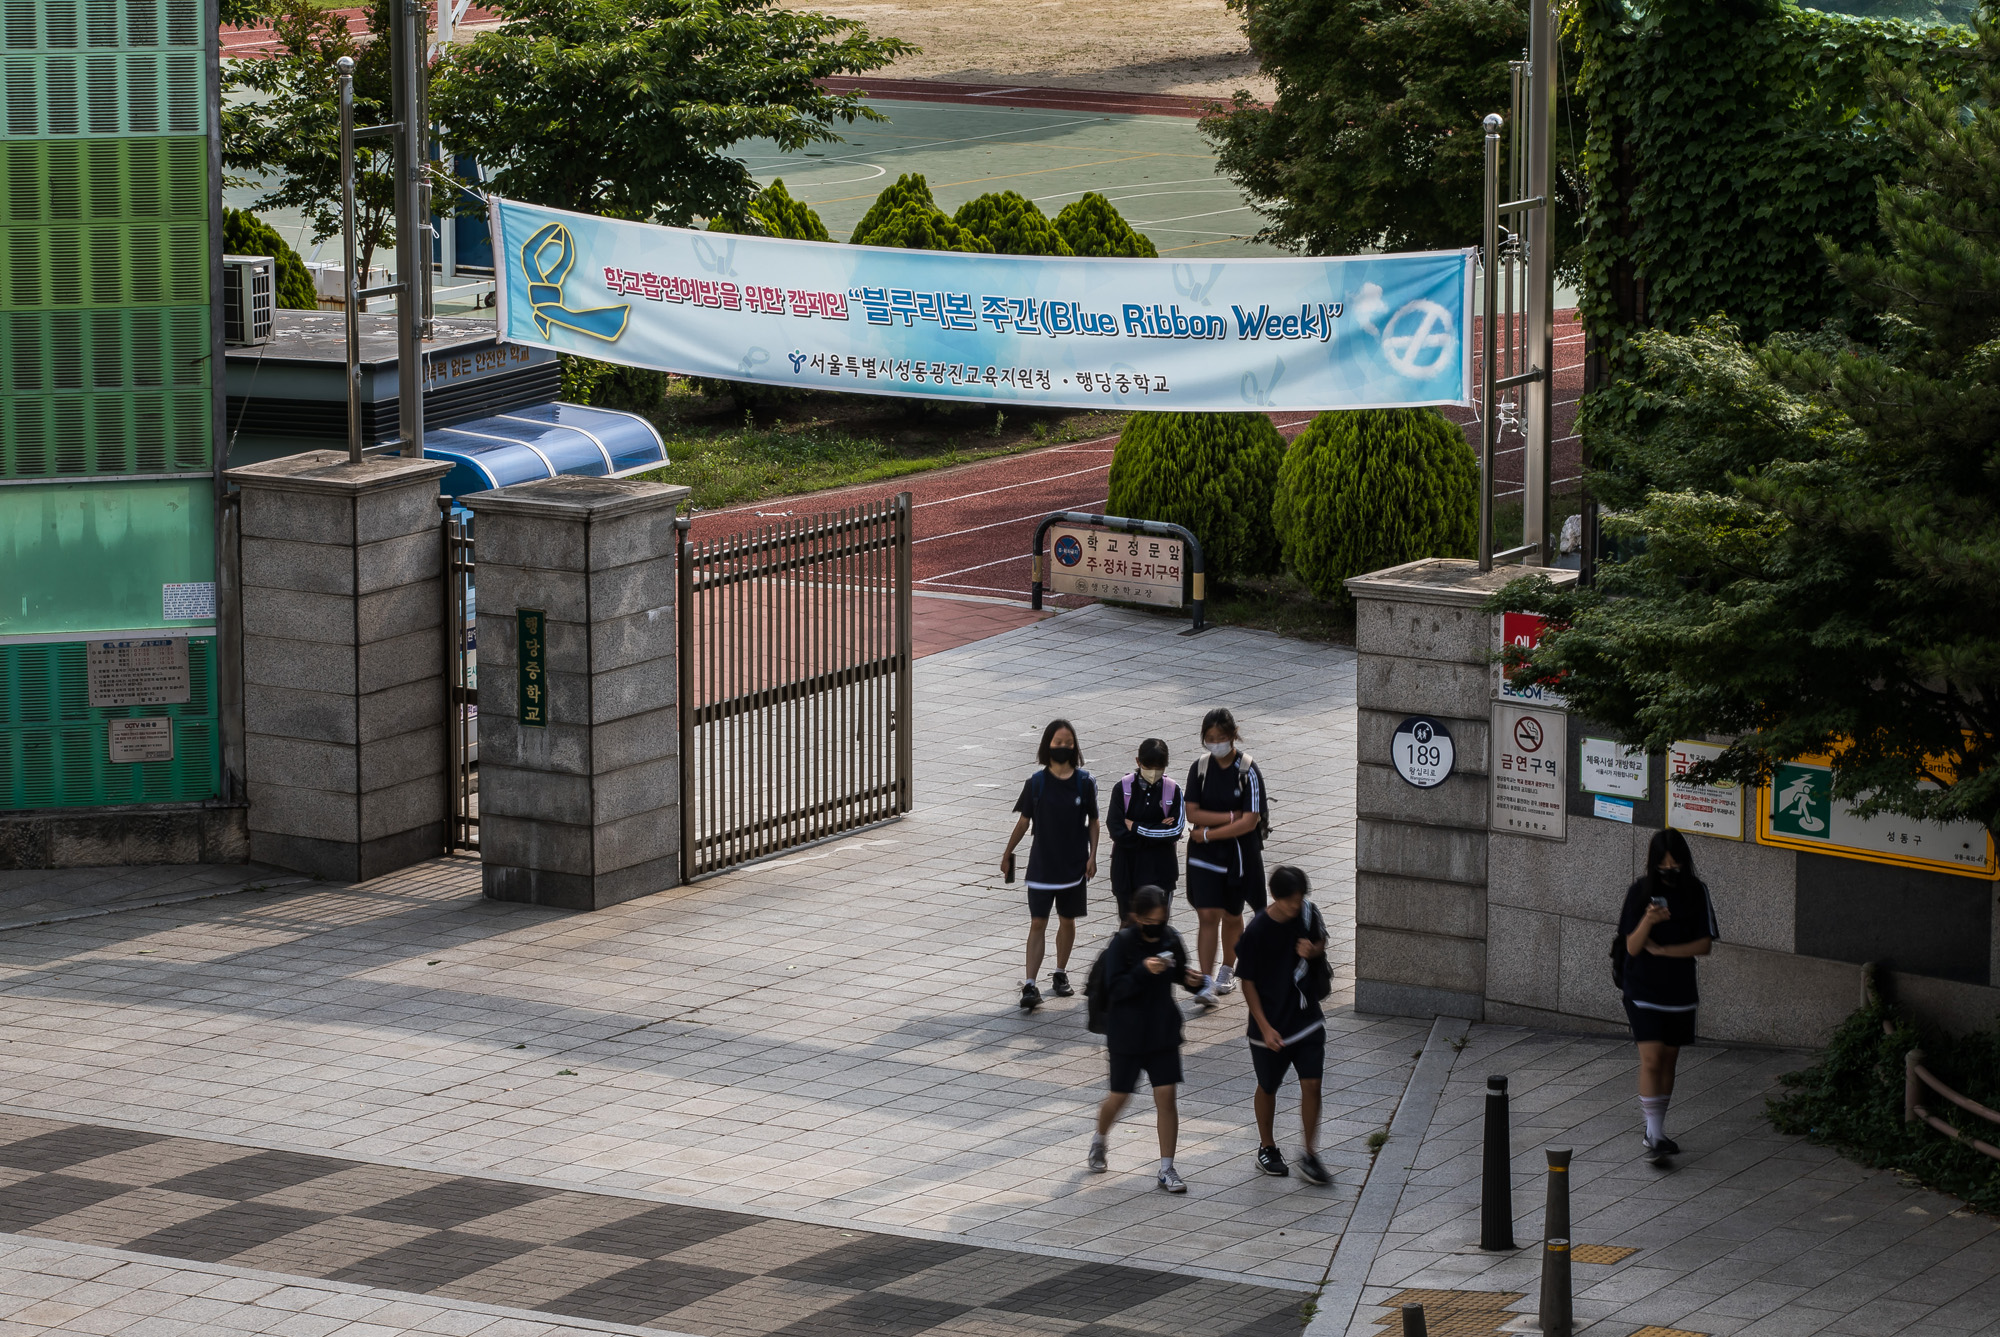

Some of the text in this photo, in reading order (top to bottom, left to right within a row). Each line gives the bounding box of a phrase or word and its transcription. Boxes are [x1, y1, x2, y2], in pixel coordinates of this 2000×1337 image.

[603, 266, 742, 311] 학교흡연예방을
[745, 285, 786, 314] 위한
[786, 289, 850, 321] 캠페인
[1121, 303, 1228, 341] Ribbon
[451, 357, 471, 378] 없는
[475, 348, 507, 373] 안전한
[510, 345, 530, 364] 학교
[810, 352, 1052, 391] 서울특별시성동광진교육지원청
[1075, 371, 1171, 395] 행당중학교
[1407, 744, 1440, 766] 189
[1501, 754, 1556, 777] 금연구역
[1586, 755, 1643, 772] 체육시설 개방학교
[1409, 767, 1436, 777] 왕십리로
[1887, 832, 1922, 846] 성동구
